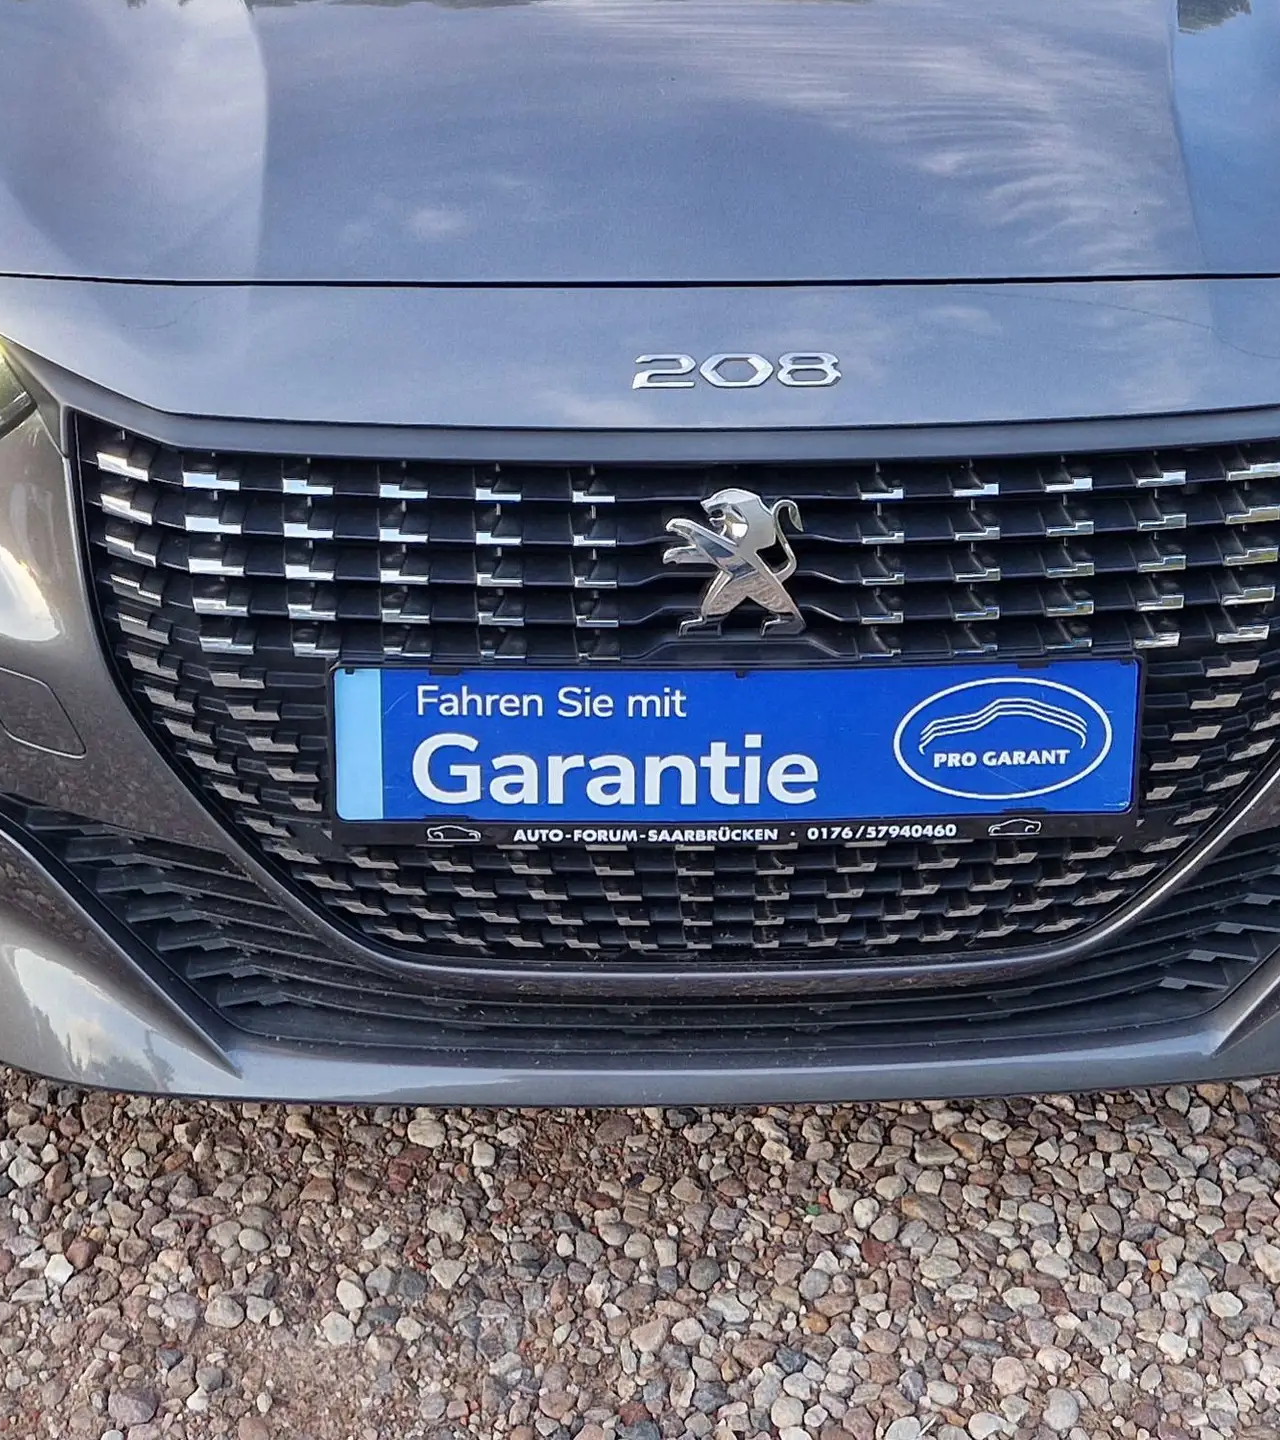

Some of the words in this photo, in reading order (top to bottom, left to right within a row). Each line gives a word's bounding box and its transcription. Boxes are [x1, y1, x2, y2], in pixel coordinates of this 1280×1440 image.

[632, 351, 842, 390] 208
[416, 684, 544, 718] Fahren
[557, 686, 614, 719] Sie
[627, 687, 687, 719] mit
[411, 733, 819, 806] Garantie
[933, 750, 978, 768] PRO
[982, 748, 1071, 766] GARANT
[513, 825, 778, 842] AUTO-FORUM-SAARBRÜCKEN
[807, 823, 957, 841] 0176/57940460
